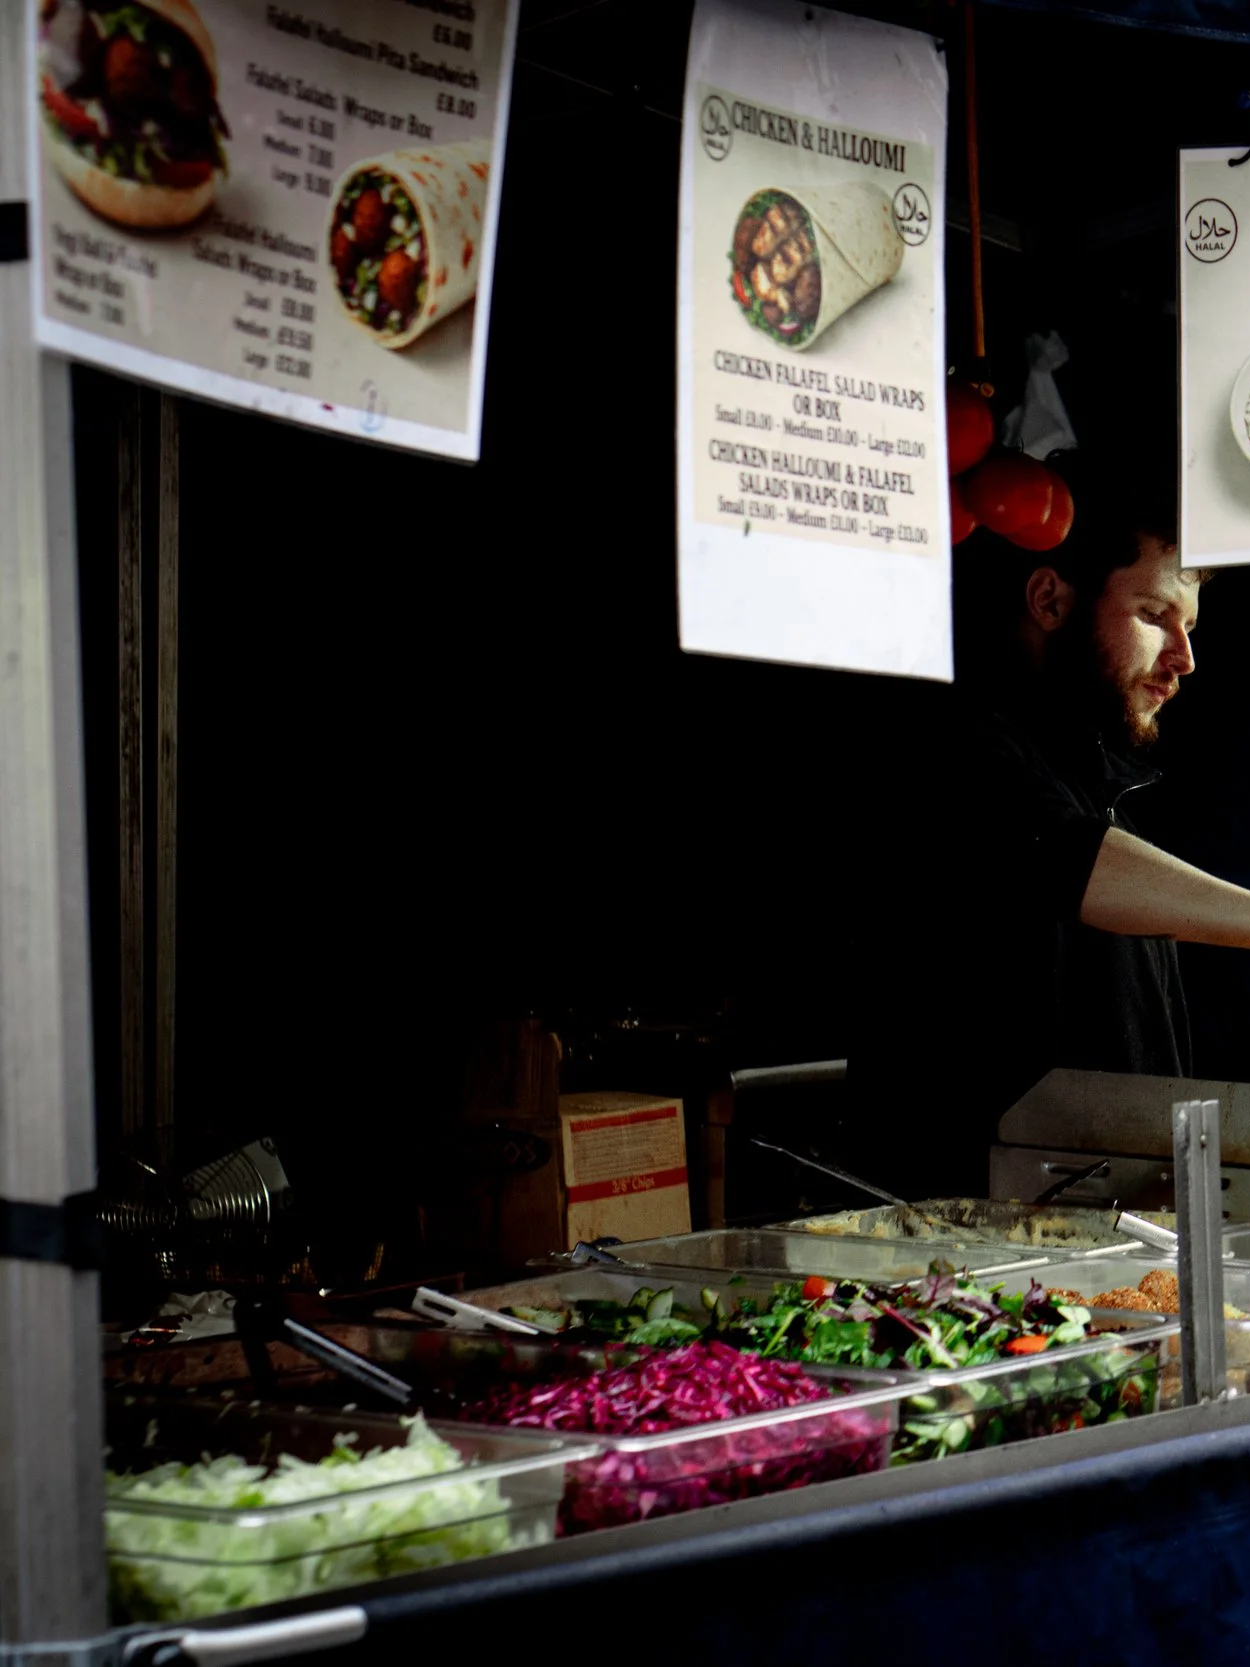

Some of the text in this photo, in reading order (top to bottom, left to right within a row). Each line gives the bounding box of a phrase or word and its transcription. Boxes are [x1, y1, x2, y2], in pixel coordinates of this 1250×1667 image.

[408, 52, 479, 90] Sandwich
[343, 95, 386, 128] Wraps
[389, 114, 404, 130] or
[406, 112, 432, 140] Box
[732, 100, 798, 146] CHICKEN
[801, 122, 814, 151] &
[817, 125, 906, 173] HALLOUMI
[1195, 242, 1225, 251] HALAL
[713, 349, 925, 412] CHICKEN FALAFEL SALAD WRAPS
[715, 403, 742, 426] Small
[782, 417, 823, 441] Medium
[868, 432, 894, 457] Large
[793, 393, 842, 422] OR BOX
[709, 438, 915, 495] CHICKEN HALLOUMI & FALAFEL
[739, 471, 889, 516] SALADS WRAPS OR BOX
[718, 494, 745, 516] Small
[786, 506, 827, 529] Medium
[868, 519, 895, 543] Large
